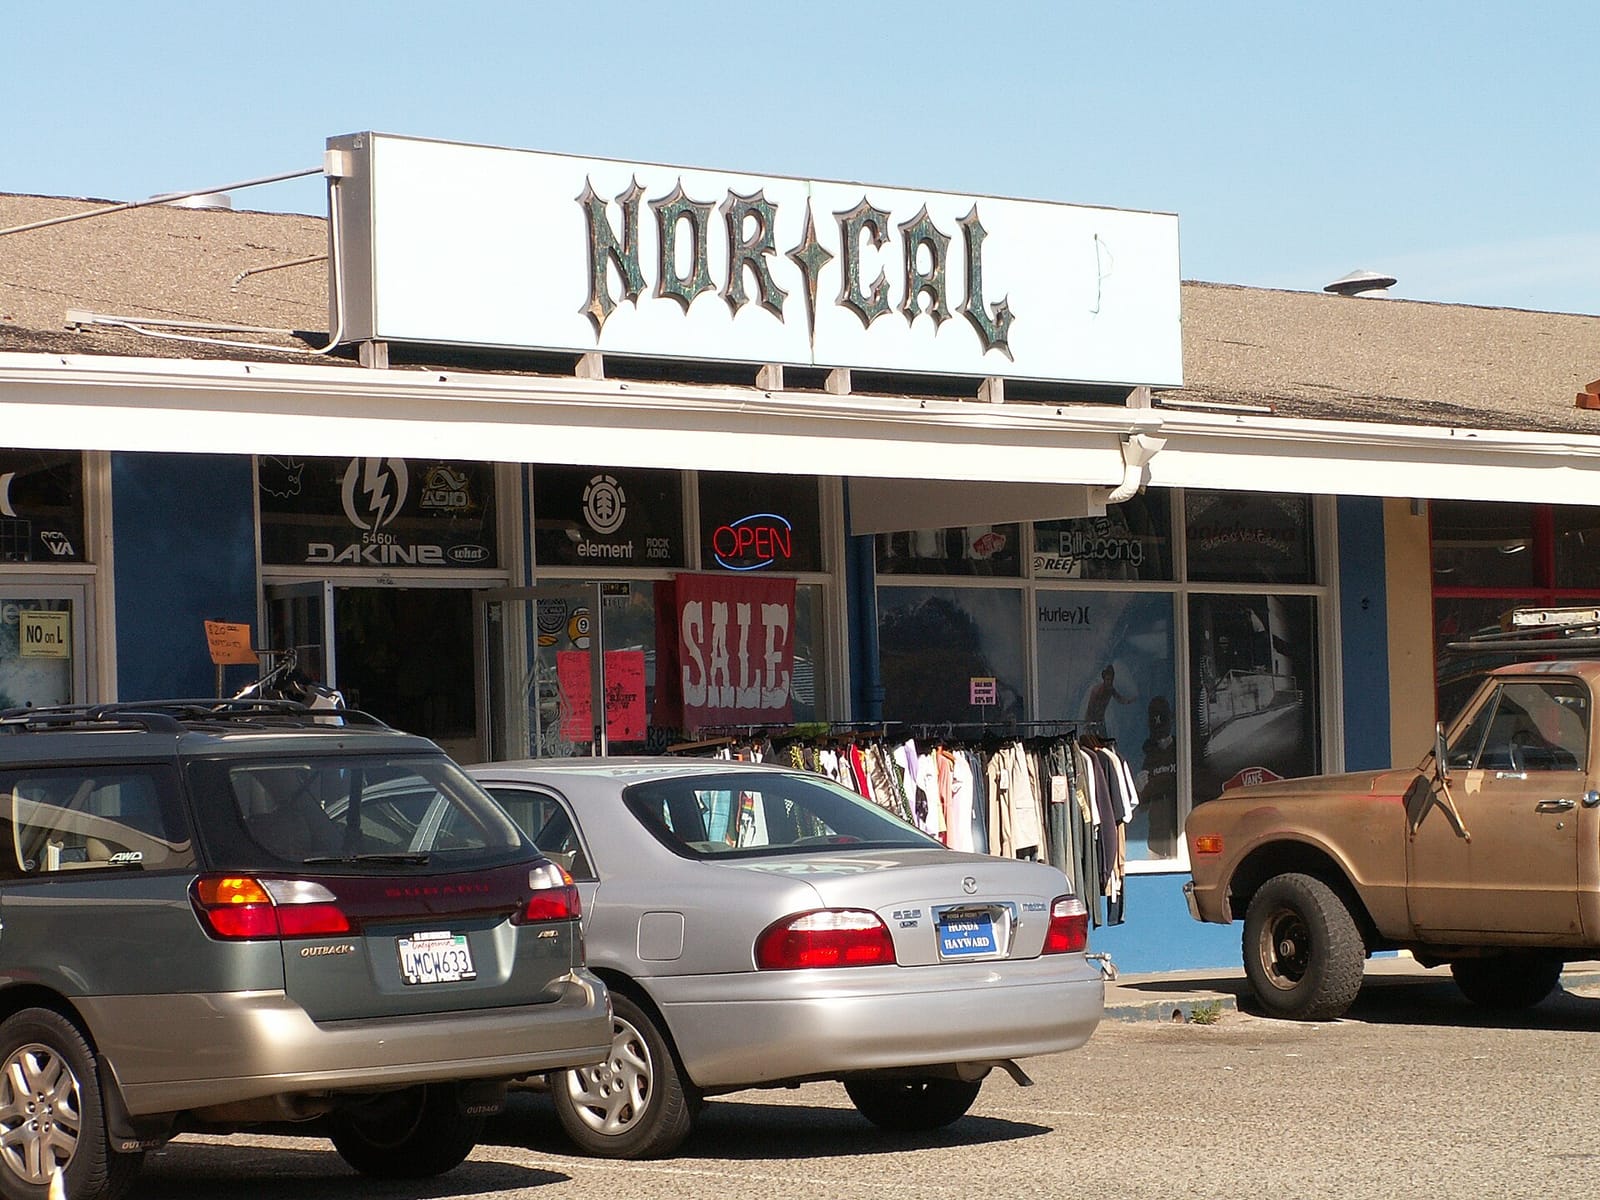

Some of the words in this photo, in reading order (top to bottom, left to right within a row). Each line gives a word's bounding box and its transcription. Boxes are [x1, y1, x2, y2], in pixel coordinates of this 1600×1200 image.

[575, 173, 789, 345] NOR
[832, 195, 1016, 362] CAL
[577, 539, 633, 558] element
[646, 538, 670, 548] ROCK
[713, 525, 791, 558] OPEN
[305, 543, 446, 564] DAKINE
[454, 547, 483, 559] what
[1045, 558, 1077, 574] REEF
[1039, 606, 1076, 624] Hurley
[26, 625, 42, 643] NO
[45, 632, 55, 643] on
[57, 625, 63, 643] L
[682, 600, 789, 709] SALE
[1241, 770, 1264, 786] VANS
[109, 851, 143, 862] AWD
[948, 922, 979, 932] HONDA
[301, 944, 349, 956] OUTBACK
[944, 937, 990, 949] HAYWARD
[405, 950, 469, 979] 4MCW633
